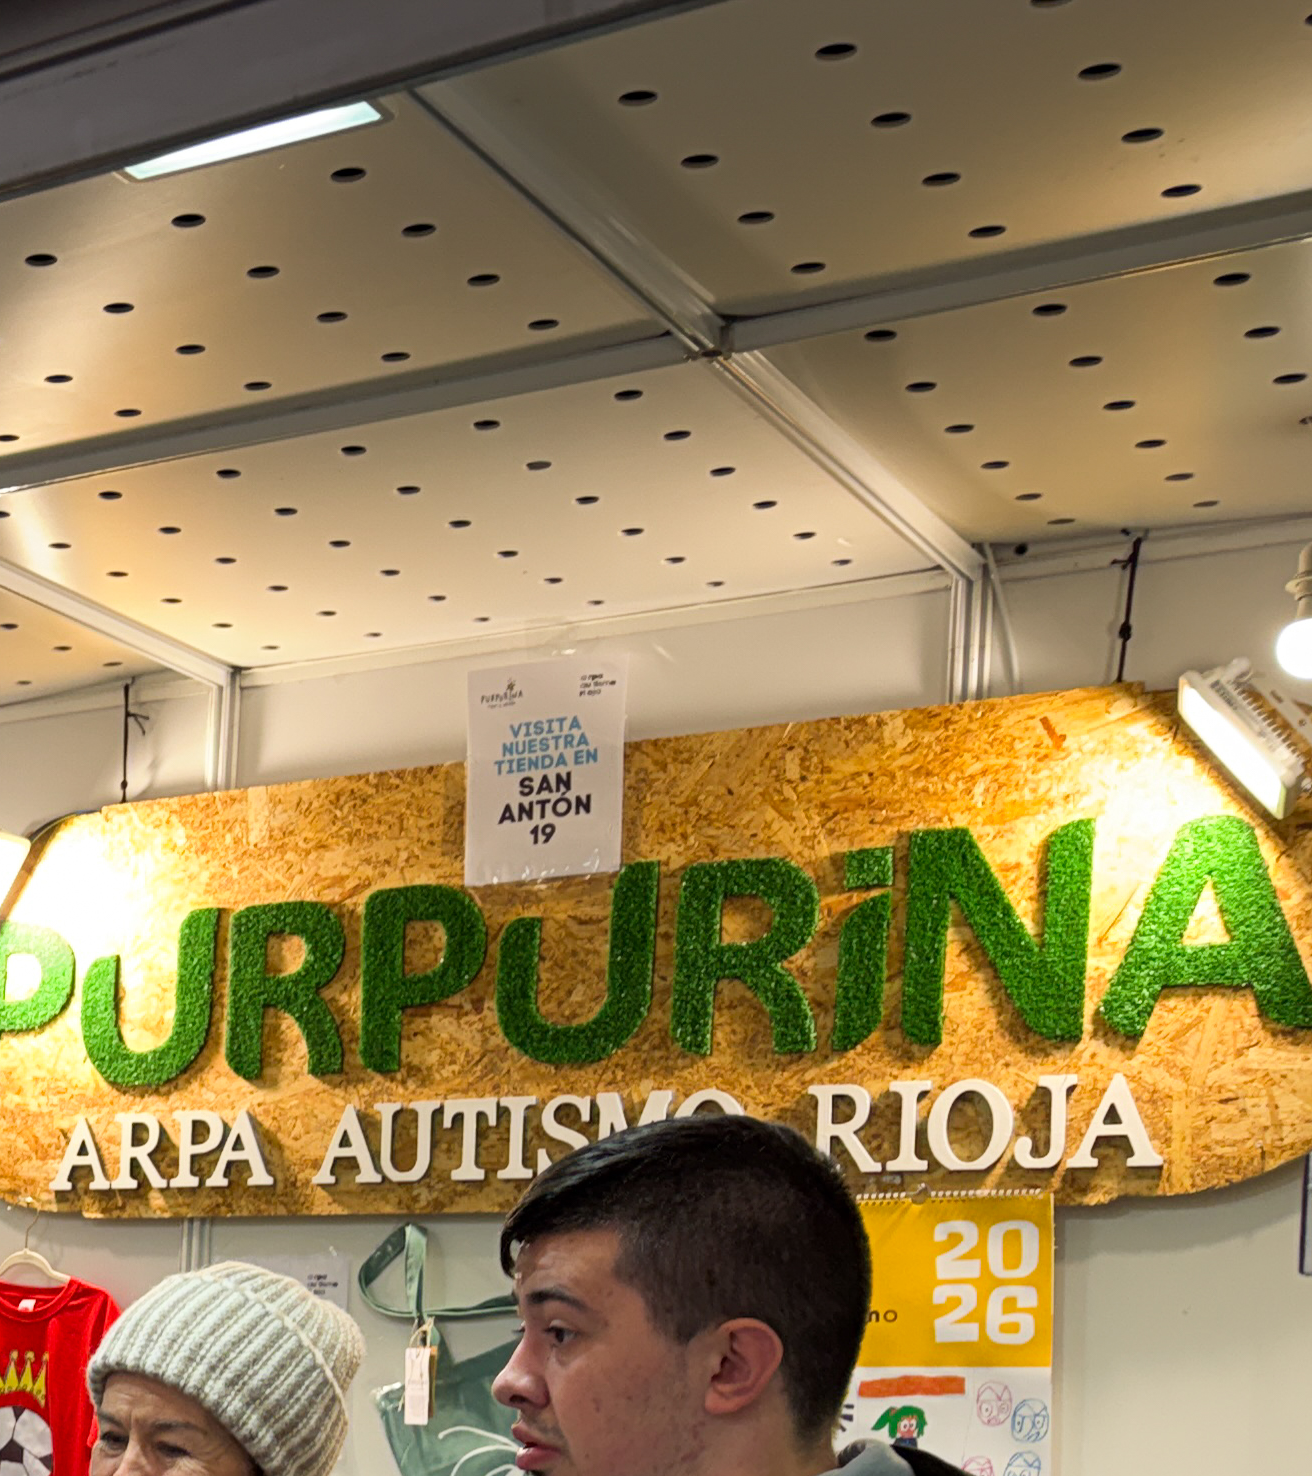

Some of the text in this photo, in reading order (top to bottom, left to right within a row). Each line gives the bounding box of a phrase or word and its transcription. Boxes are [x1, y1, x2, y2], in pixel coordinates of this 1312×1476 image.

[510, 715, 581, 738] VISITA
[502, 732, 589, 757] NUESTRA
[494, 748, 598, 775] TIENDA EN
[519, 771, 571, 797] SAN
[498, 790, 591, 824] ANTÓN
[530, 823, 556, 844] 19
[49, 1108, 275, 1192] ARPA
[807, 1073, 1164, 1174] RIOJA
[933, 1219, 1040, 1280] 20
[932, 1283, 1038, 1345] 26
